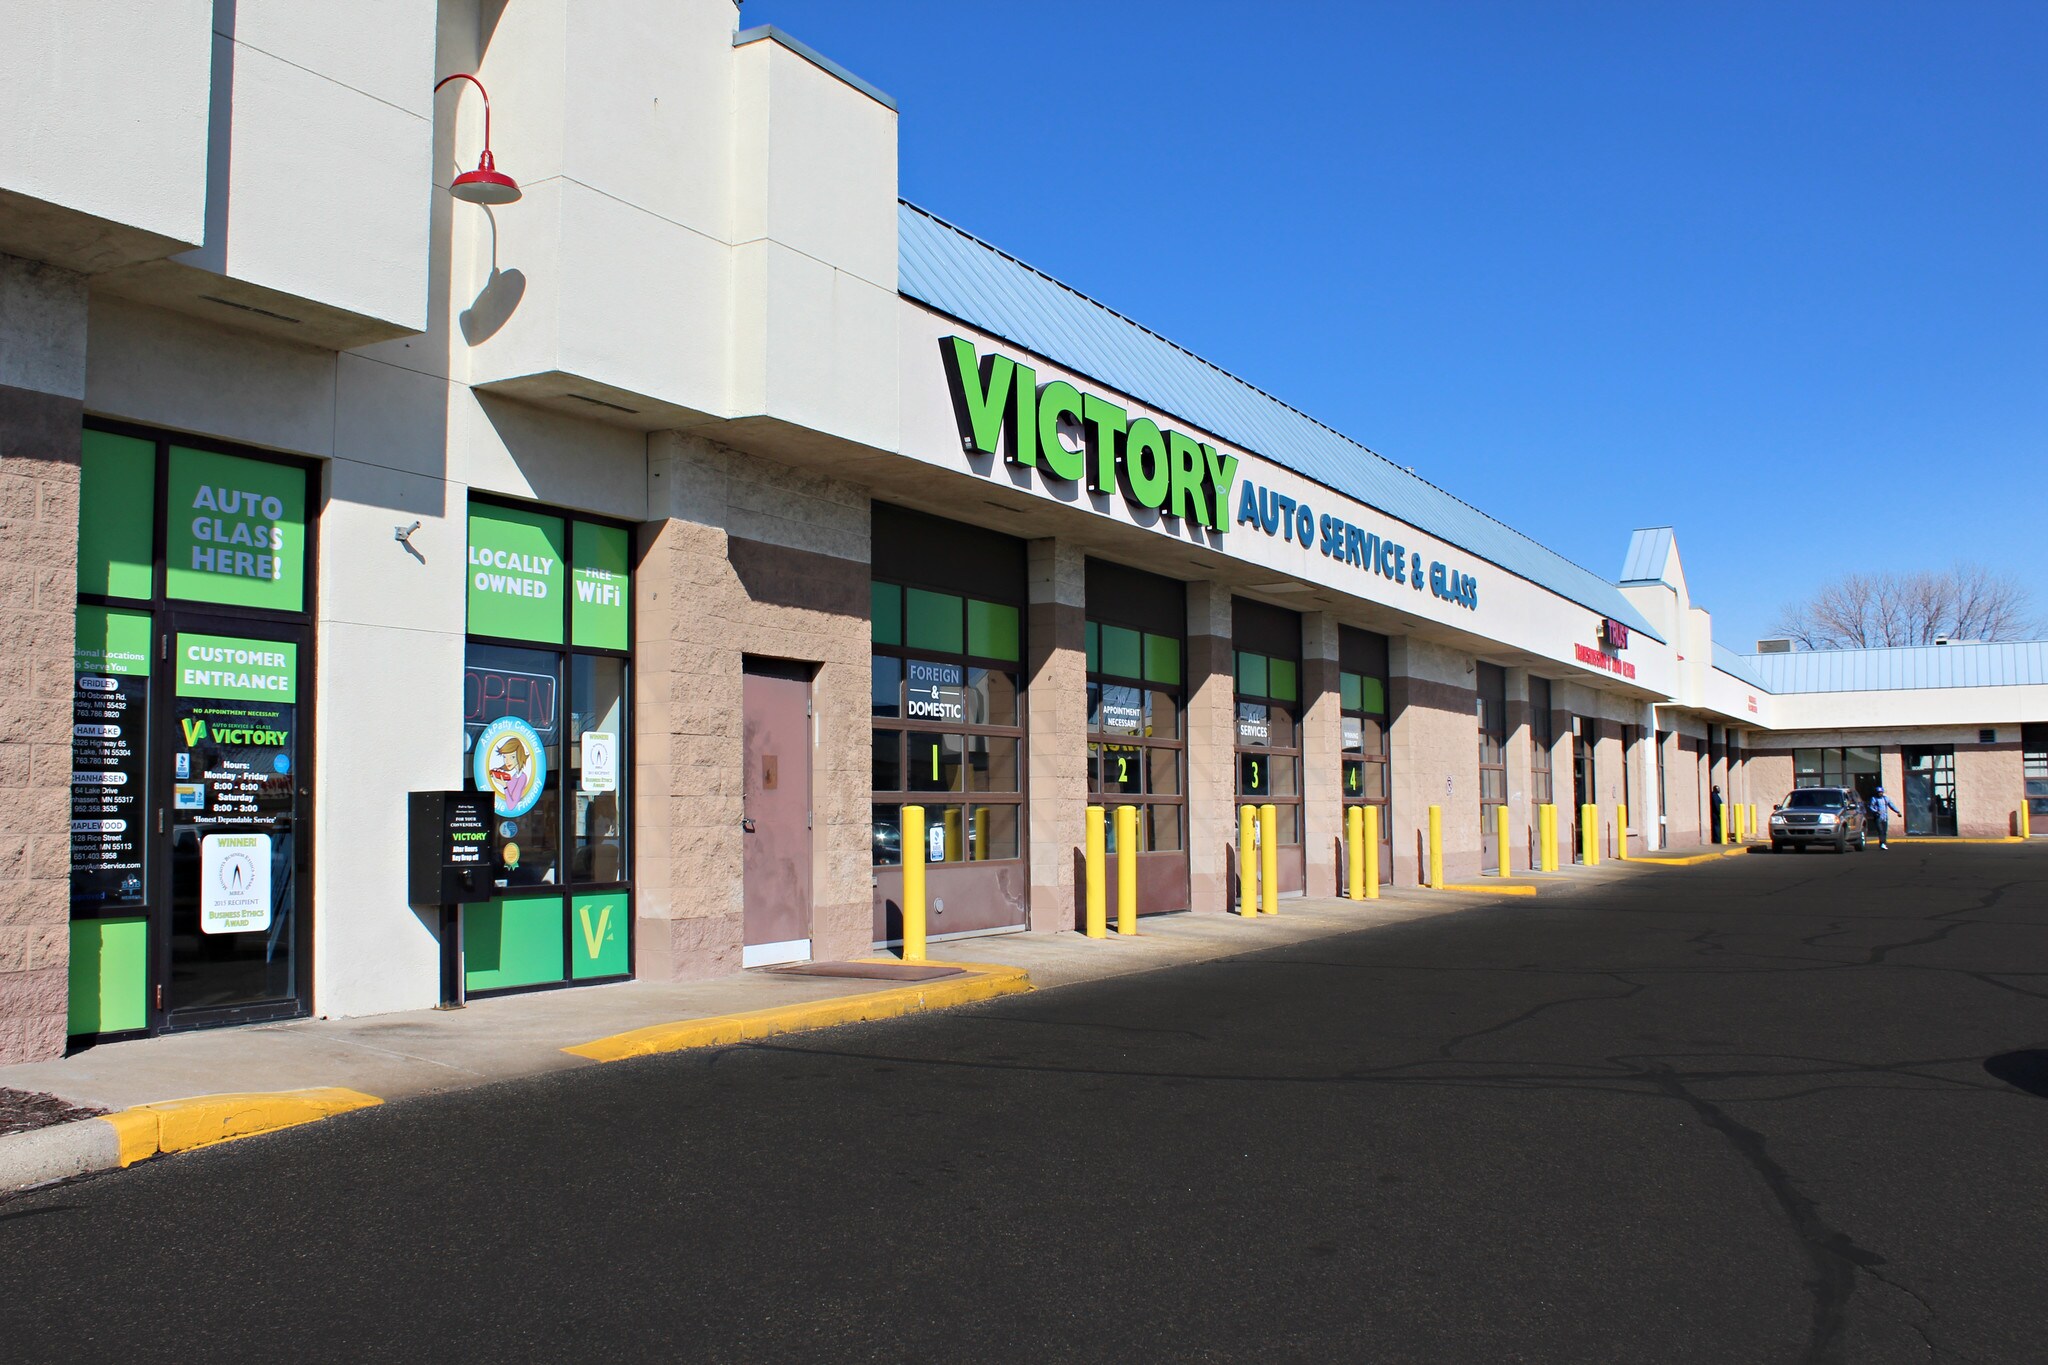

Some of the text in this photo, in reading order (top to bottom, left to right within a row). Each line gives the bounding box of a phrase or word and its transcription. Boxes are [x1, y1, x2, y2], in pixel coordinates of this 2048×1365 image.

[938, 336, 1238, 532] VICTORY
[192, 485, 283, 520] AUTO
[192, 517, 283, 550] GLASS
[1237, 480, 1477, 611] AUTO SERVICE & GLASS
[192, 546, 282, 580] HERE!
[469, 546, 554, 575] LOCALLY
[586, 567, 612, 581] FREE
[475, 573, 548, 598] OWNED
[576, 580, 620, 606] WiFi
[102, 650, 145, 660] Locations
[188, 646, 286, 667] CUSTOMER
[84, 661, 110, 670] Serve
[110, 663, 127, 672] You
[910, 665, 959, 684] FOREIGN
[82, 680, 116, 688] FRIDLEY
[184, 669, 288, 691] ENTRANCE
[931, 685, 939, 699] &
[908, 700, 961, 718] DOMESTIC
[1103, 706, 1140, 716] APPOINTMENT
[1108, 718, 1136, 727] NECESSARY
[1248, 713, 1260, 724] ALL
[212, 729, 288, 746] VICTORY
[515, 721, 542, 754] Certified
[1240, 725, 1267, 737] SERVICES
[223, 761, 250, 770] Hours:
[1118, 758, 1128, 782] 2
[204, 771, 236, 780] Monday
[243, 773, 268, 782] Friday
[1252, 762, 1258, 788] 3
[1350, 768, 1356, 790] 4
[218, 794, 254, 802] Saturday
[518, 777, 542, 810] Friendly
[217, 838, 257, 847] WINNER!
[209, 911, 240, 919] BUSINESS
[225, 919, 249, 927] AWARD
